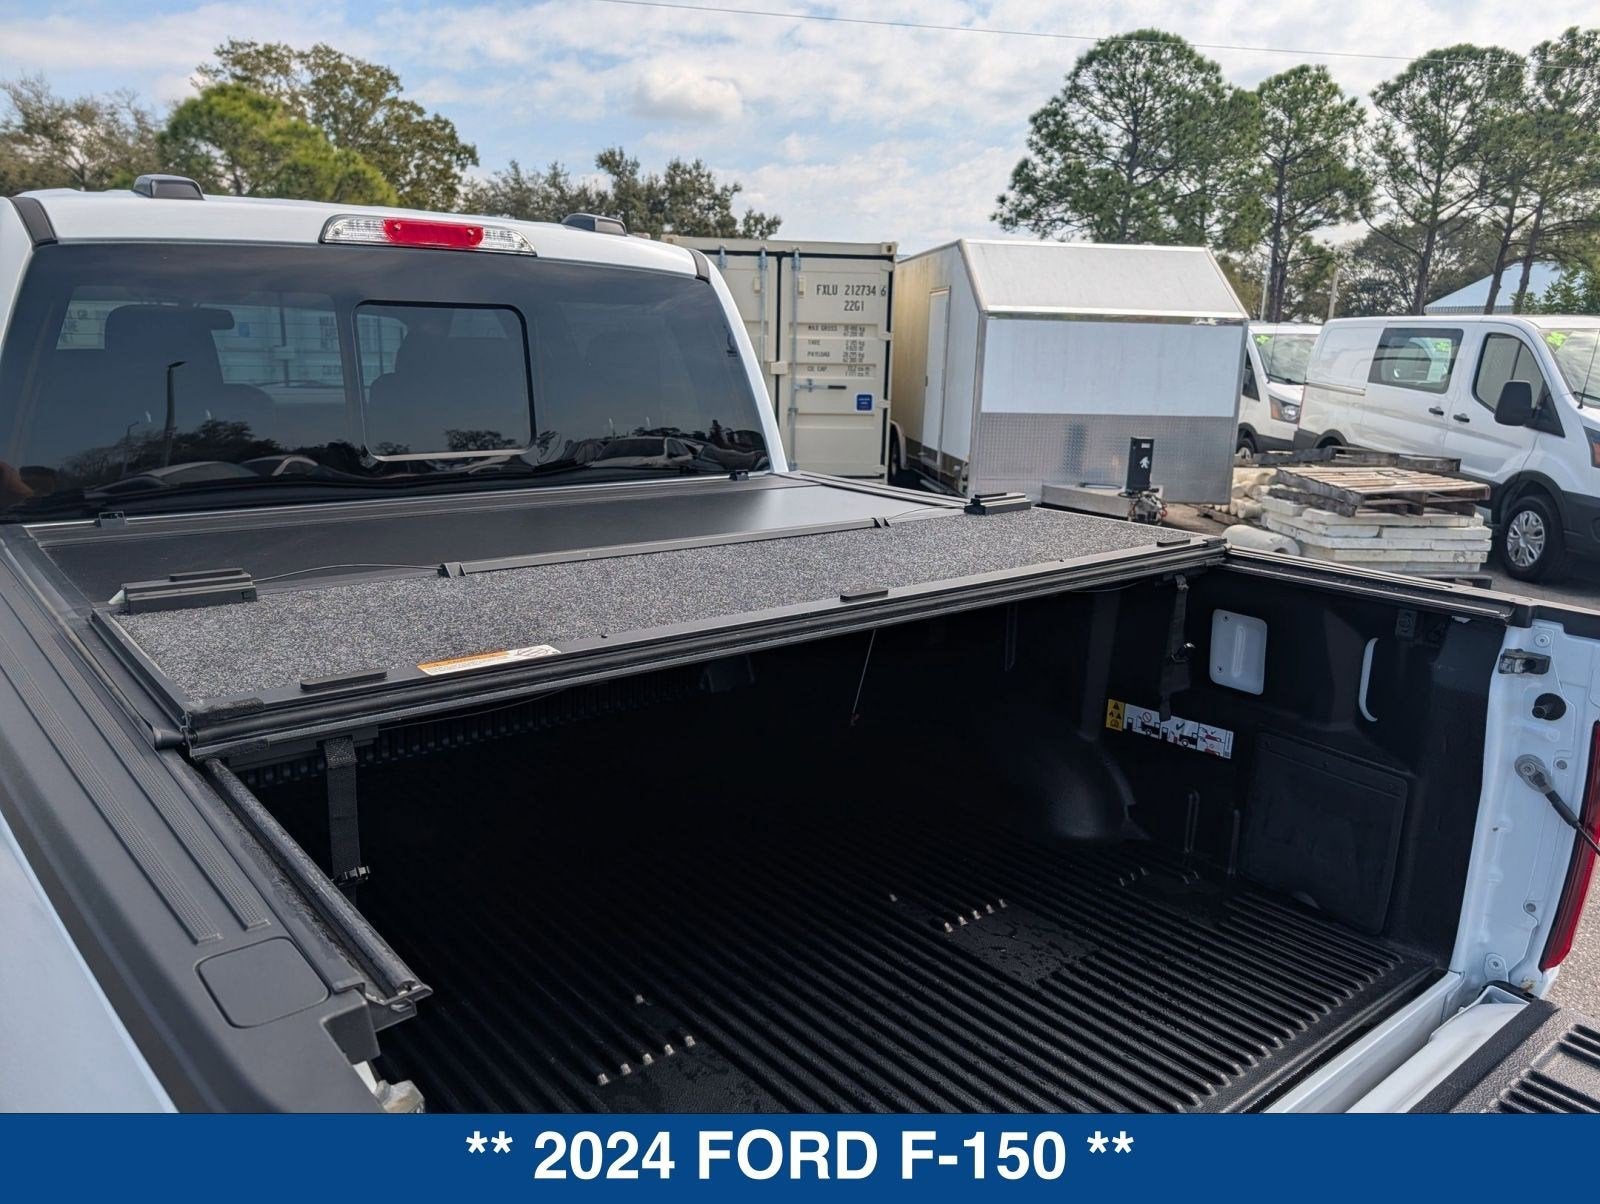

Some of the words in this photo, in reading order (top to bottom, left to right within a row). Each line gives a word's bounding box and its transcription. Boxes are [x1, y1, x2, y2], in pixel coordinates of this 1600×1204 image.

[816, 284, 838, 296] FXLU
[844, 284, 877, 296] 212734
[880, 285, 887, 297] 6
[843, 300, 865, 312] 22G1
